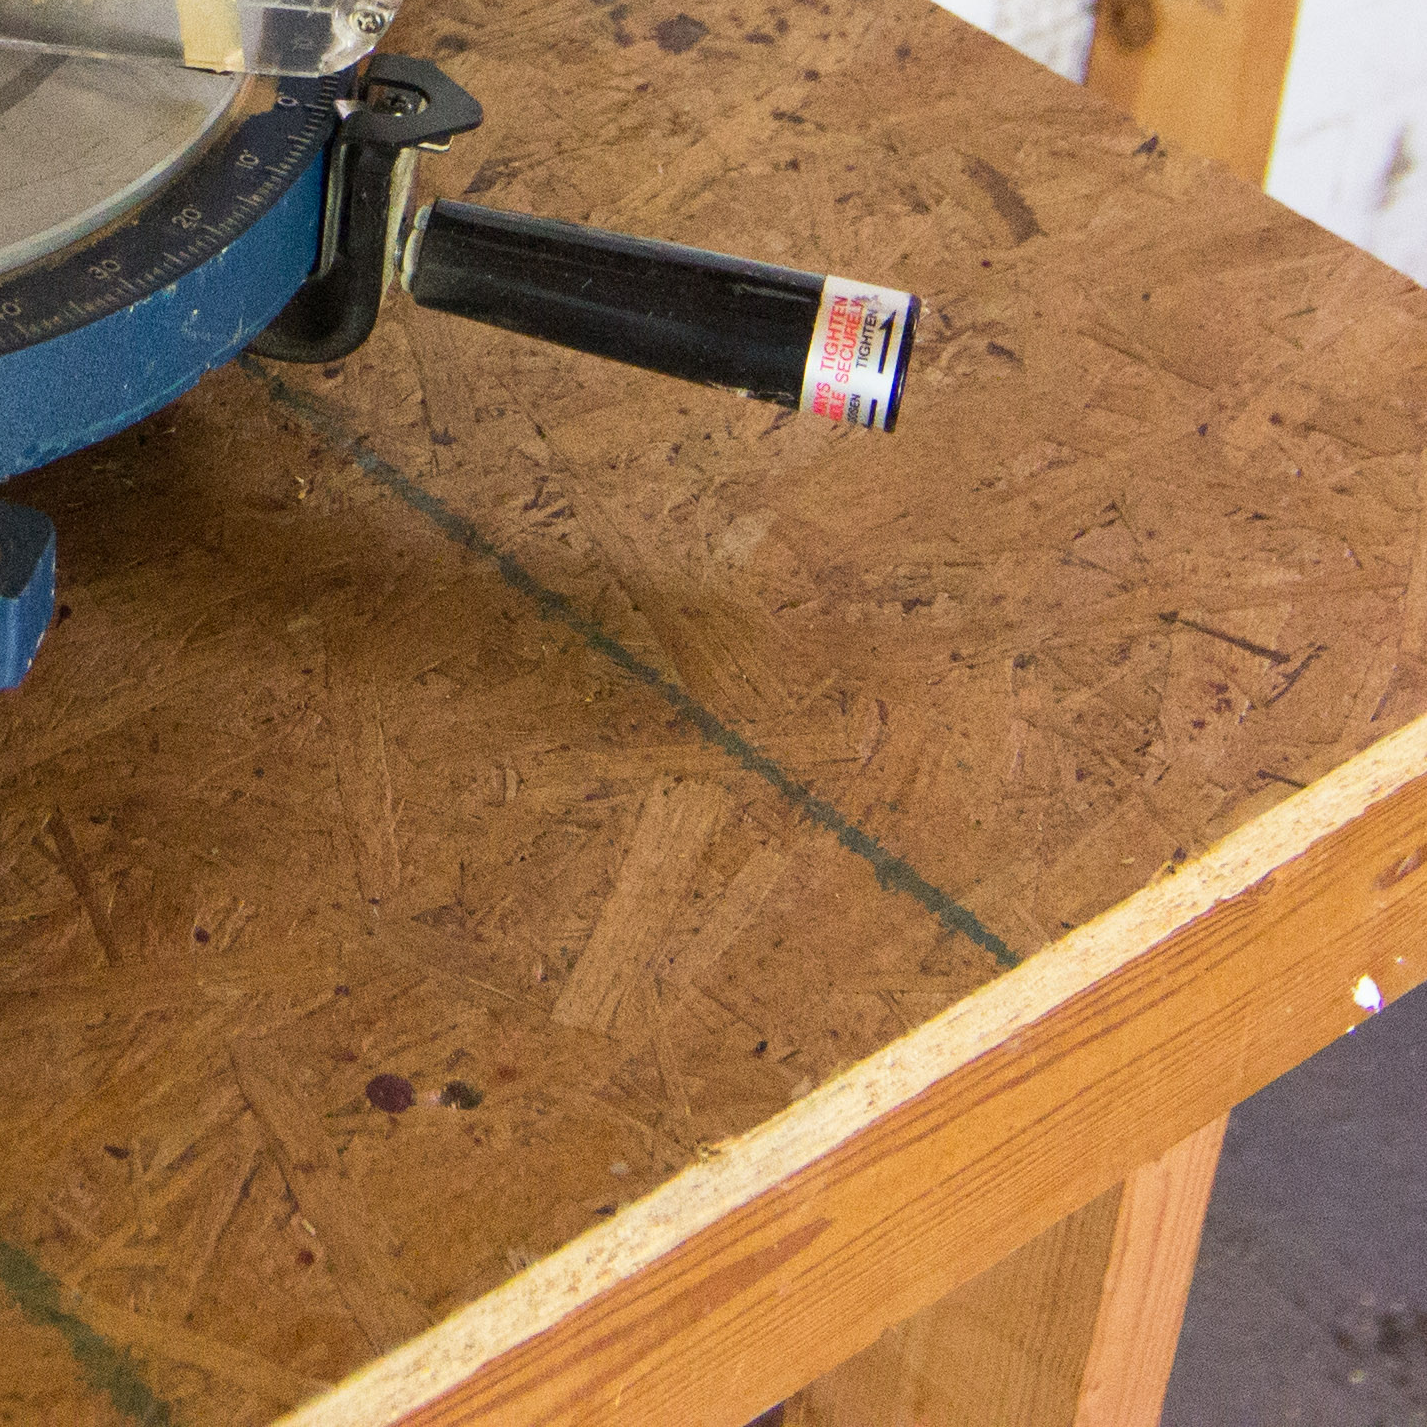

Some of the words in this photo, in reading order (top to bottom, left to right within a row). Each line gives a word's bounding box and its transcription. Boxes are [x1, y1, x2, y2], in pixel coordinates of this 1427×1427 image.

[820, 295, 848, 371] TIGHTEN
[835, 297, 864, 384] SECURELY
[856, 308, 878, 369] TIGHTEN
